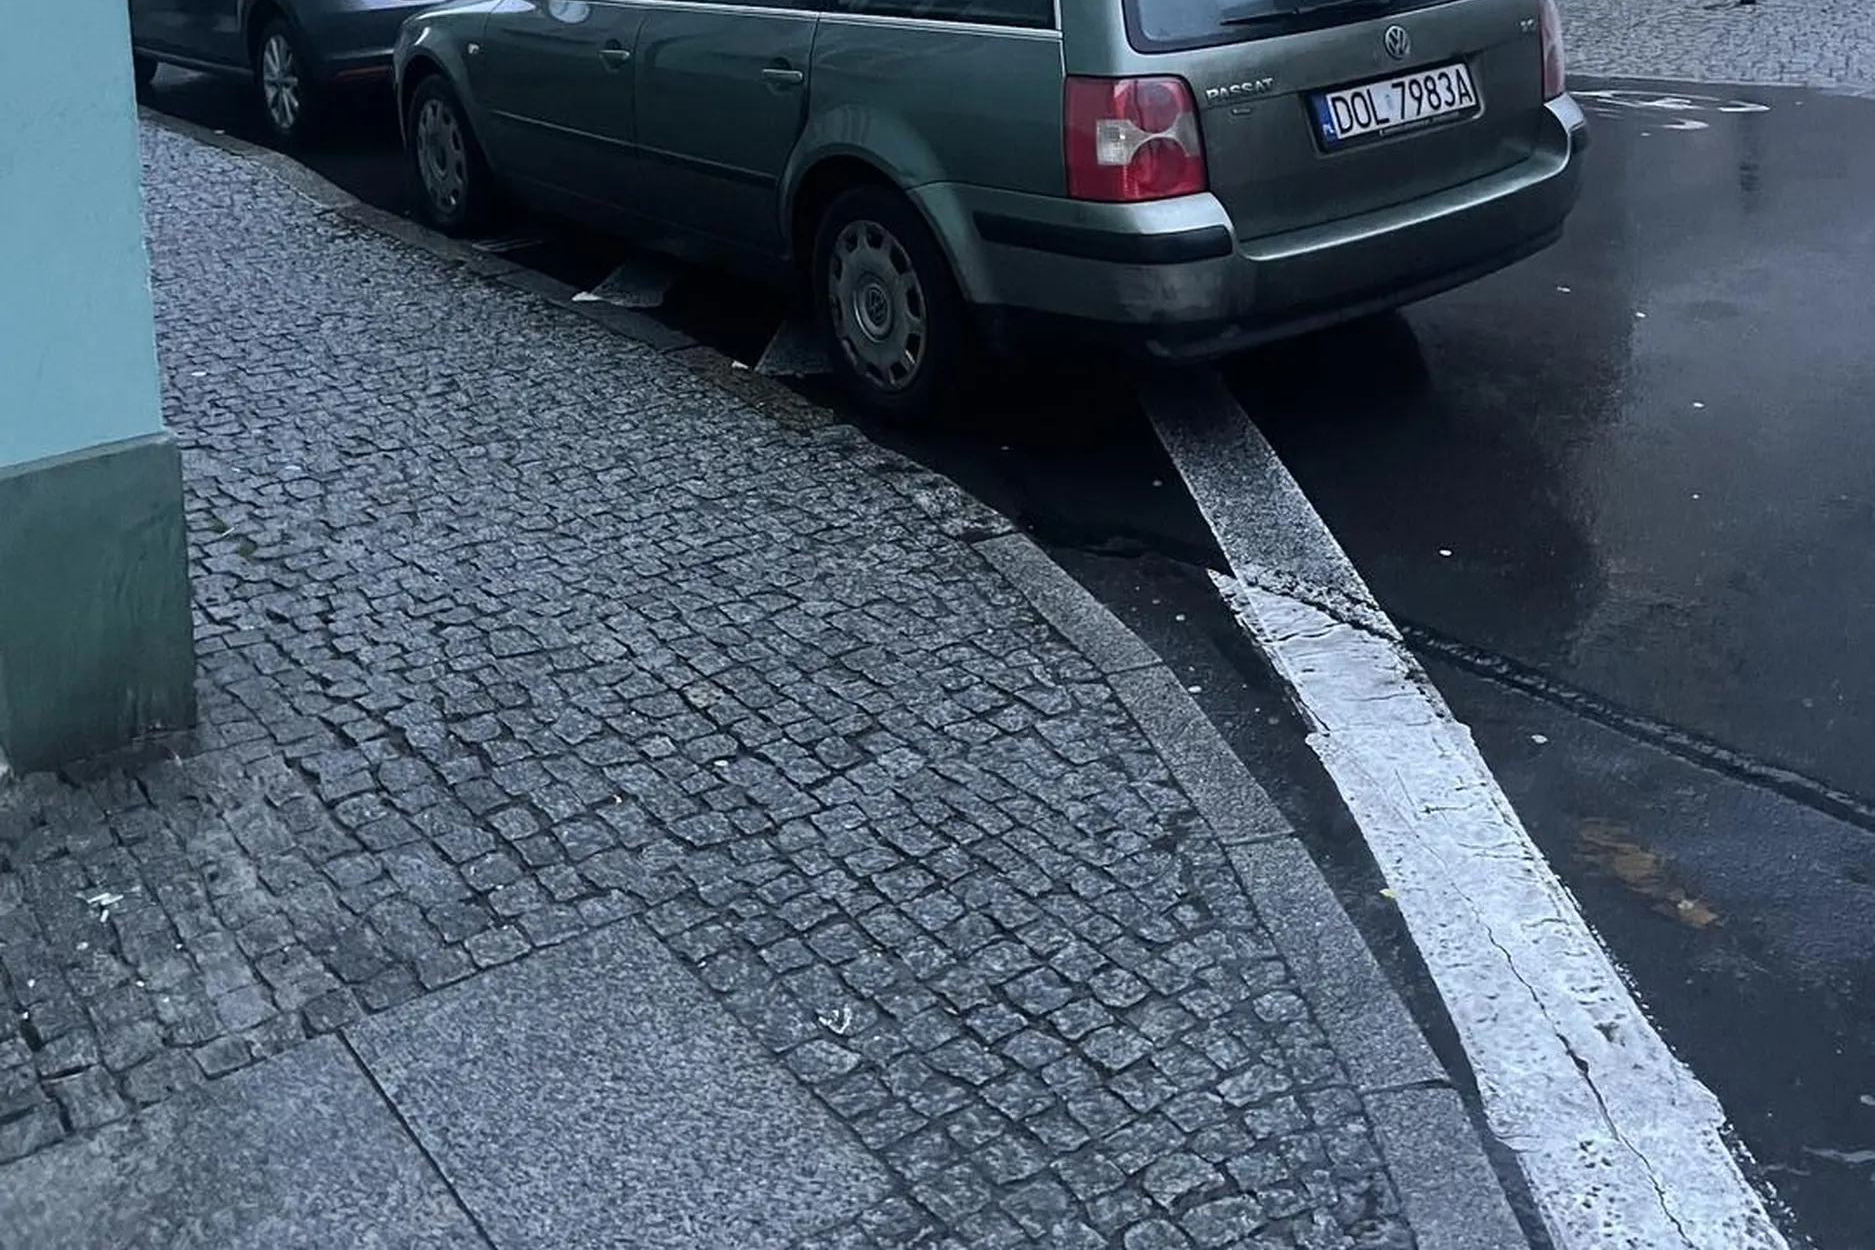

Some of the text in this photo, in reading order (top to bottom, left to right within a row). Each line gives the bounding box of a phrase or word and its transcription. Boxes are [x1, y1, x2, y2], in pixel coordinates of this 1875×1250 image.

[1205, 77, 1273, 100] PASSAT
[1331, 87, 1390, 135] DOL
[1391, 68, 1474, 120] 7983A
